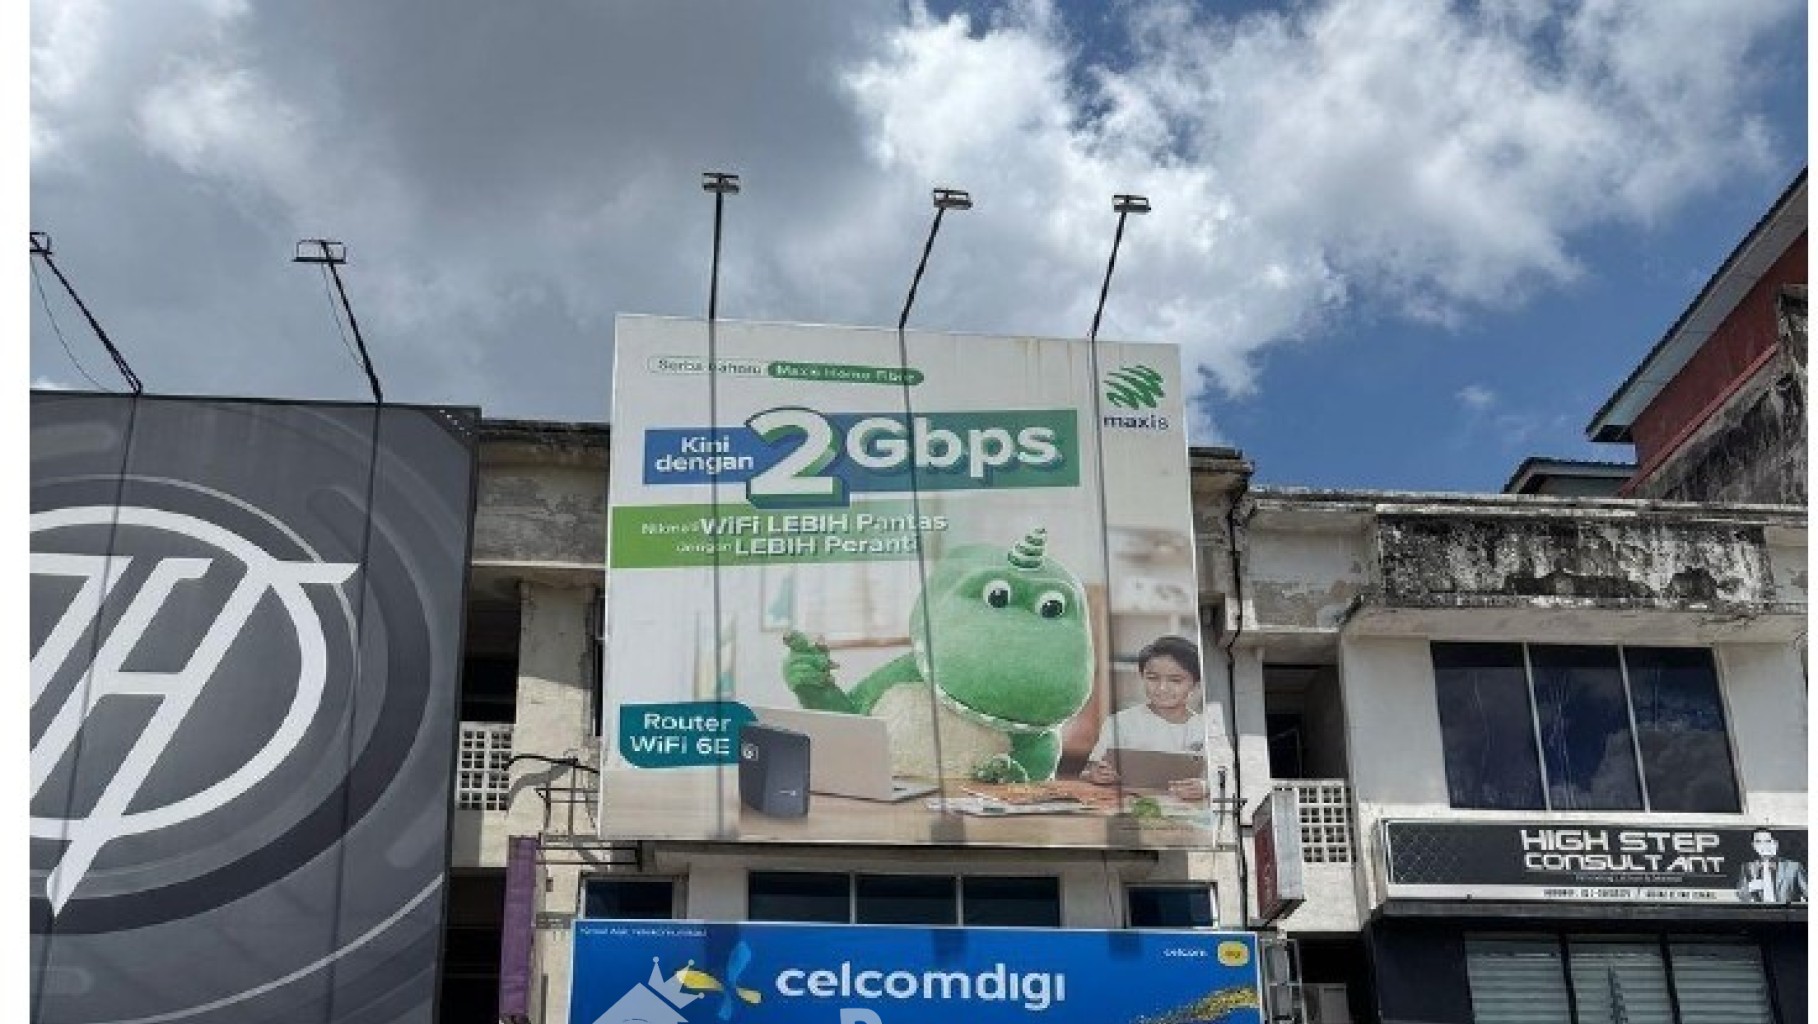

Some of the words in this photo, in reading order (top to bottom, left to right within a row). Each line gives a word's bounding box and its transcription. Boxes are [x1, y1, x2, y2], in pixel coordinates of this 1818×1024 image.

[1103, 413, 1170, 430] maxis
[681, 435, 730, 453] Kini
[747, 408, 838, 497] 2
[845, 416, 1059, 478] Gbps
[655, 453, 754, 474] dengan
[700, 515, 760, 535] WiFi
[768, 514, 848, 533] LEBIH
[857, 512, 949, 533] Pantas
[736, 537, 817, 556] LEBIH
[643, 713, 732, 732] Router
[629, 735, 687, 754] WiFi
[696, 738, 730, 754] 6E
[1520, 829, 1609, 851] HIGH
[1619, 831, 1720, 852] STEP
[1524, 853, 1724, 873] CONSULTANT
